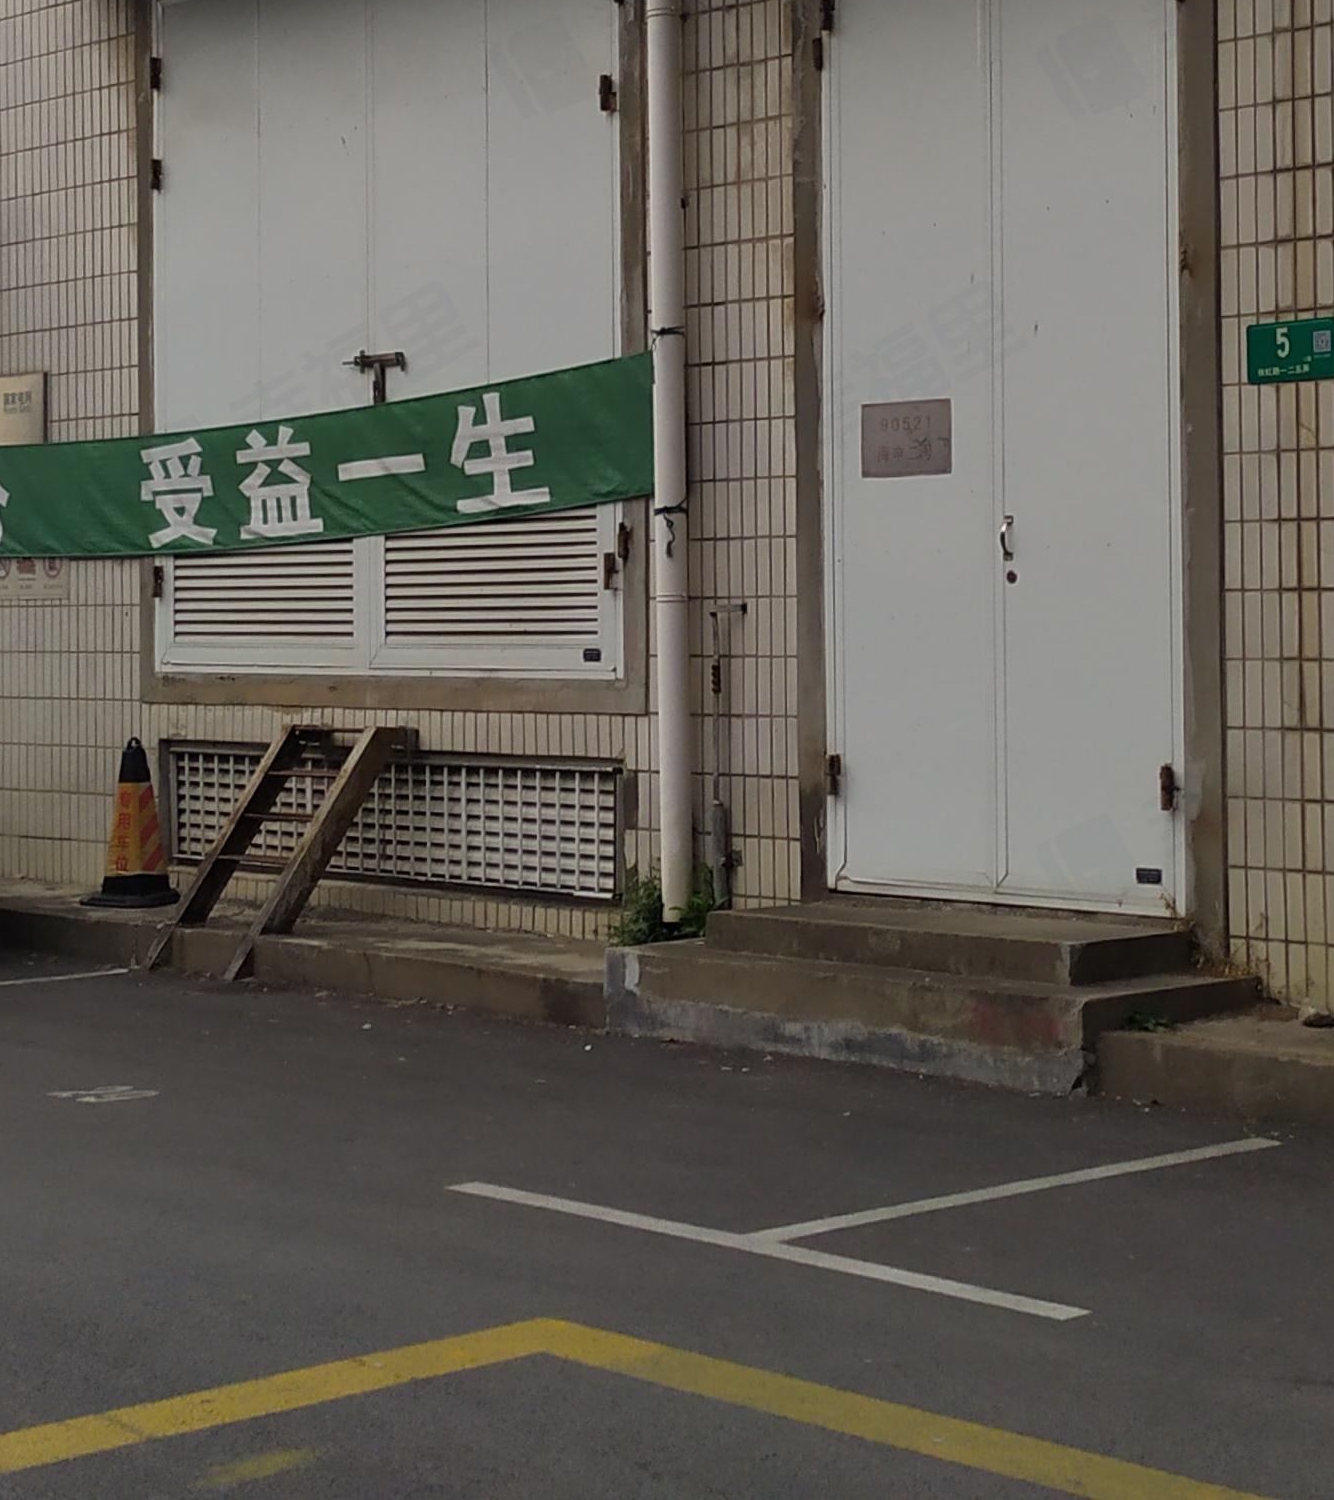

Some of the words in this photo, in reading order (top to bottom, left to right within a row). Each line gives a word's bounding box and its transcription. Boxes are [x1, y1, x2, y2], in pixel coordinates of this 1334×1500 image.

[1275, 326, 1290, 358] 5
[881, 415, 931, 432] 90521
[140, 392, 551, 548] 受益一生
